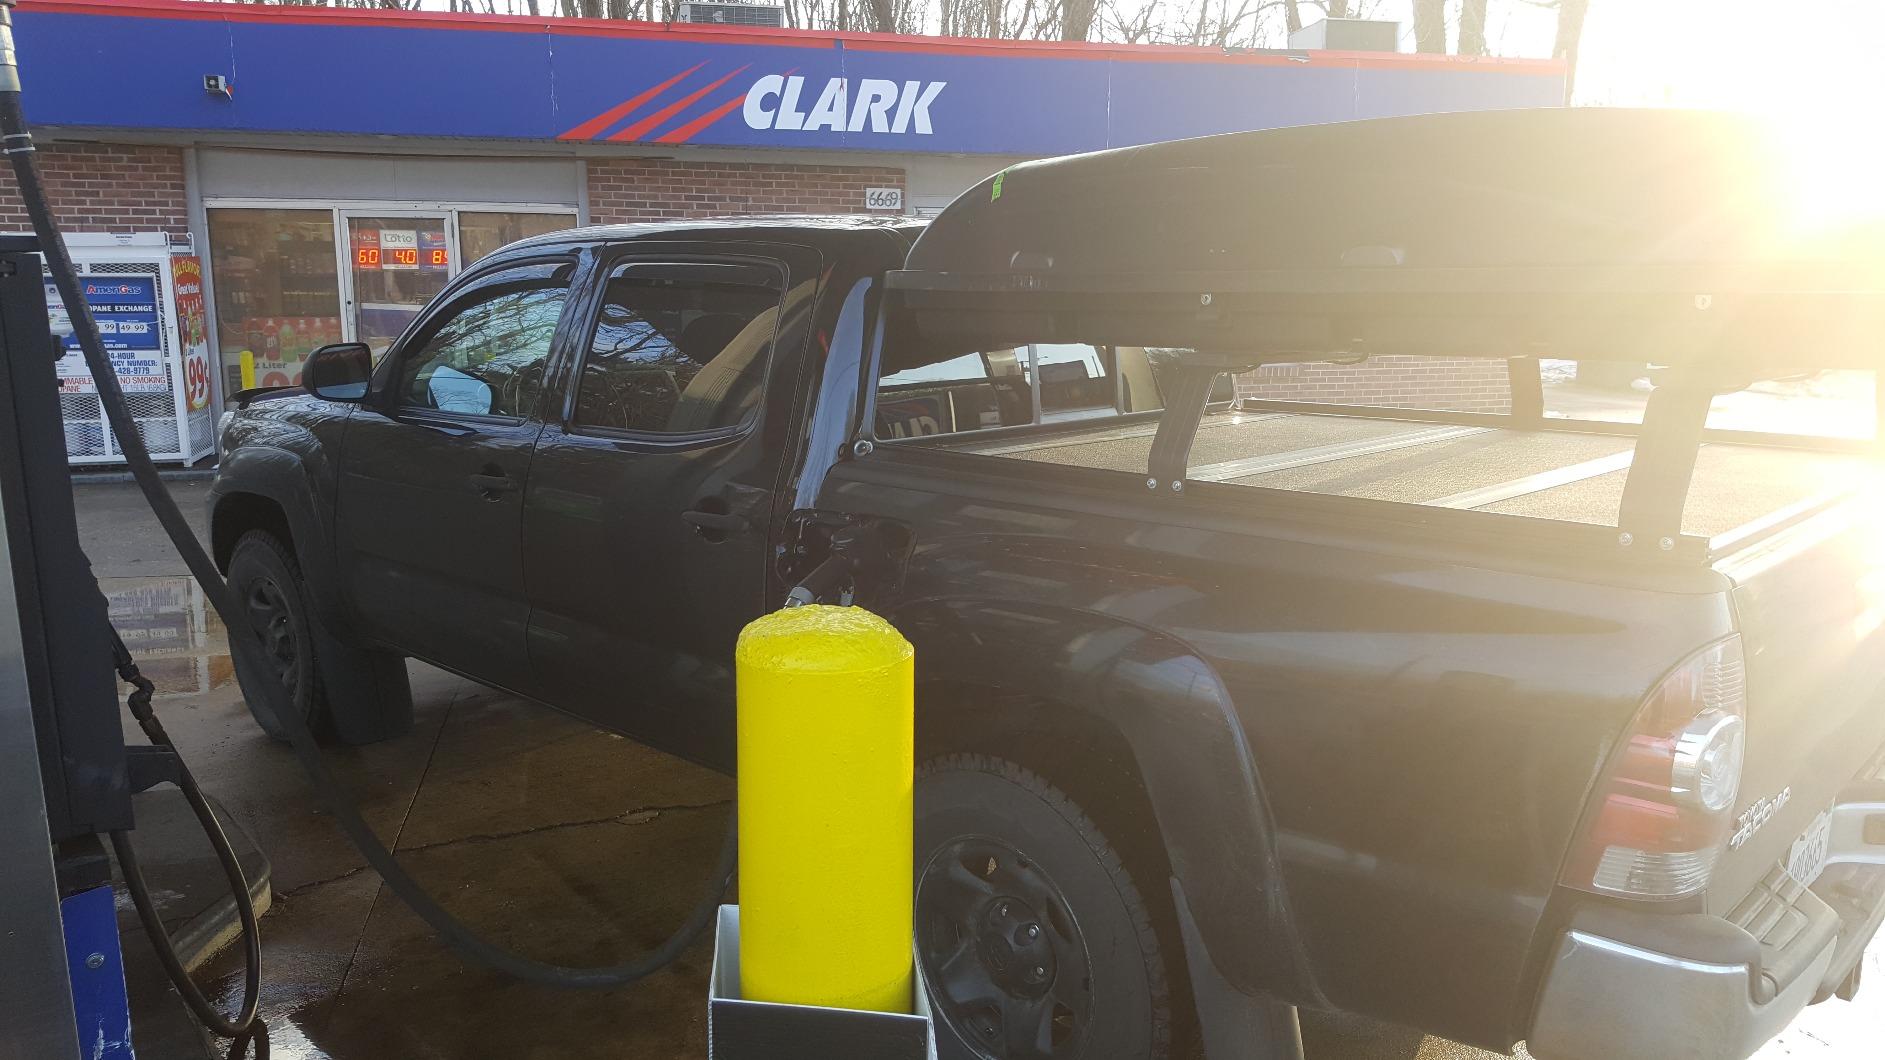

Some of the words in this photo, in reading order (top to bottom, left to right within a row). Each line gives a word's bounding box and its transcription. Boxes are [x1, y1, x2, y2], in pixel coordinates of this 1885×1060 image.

[742, 74, 948, 134] CLARK
[868, 191, 899, 207] 6669
[384, 233, 413, 243] Lotto
[358, 249, 378, 263] 60
[86, 284, 142, 295] AmeriGas
[132, 376, 166, 384] SMOKING
